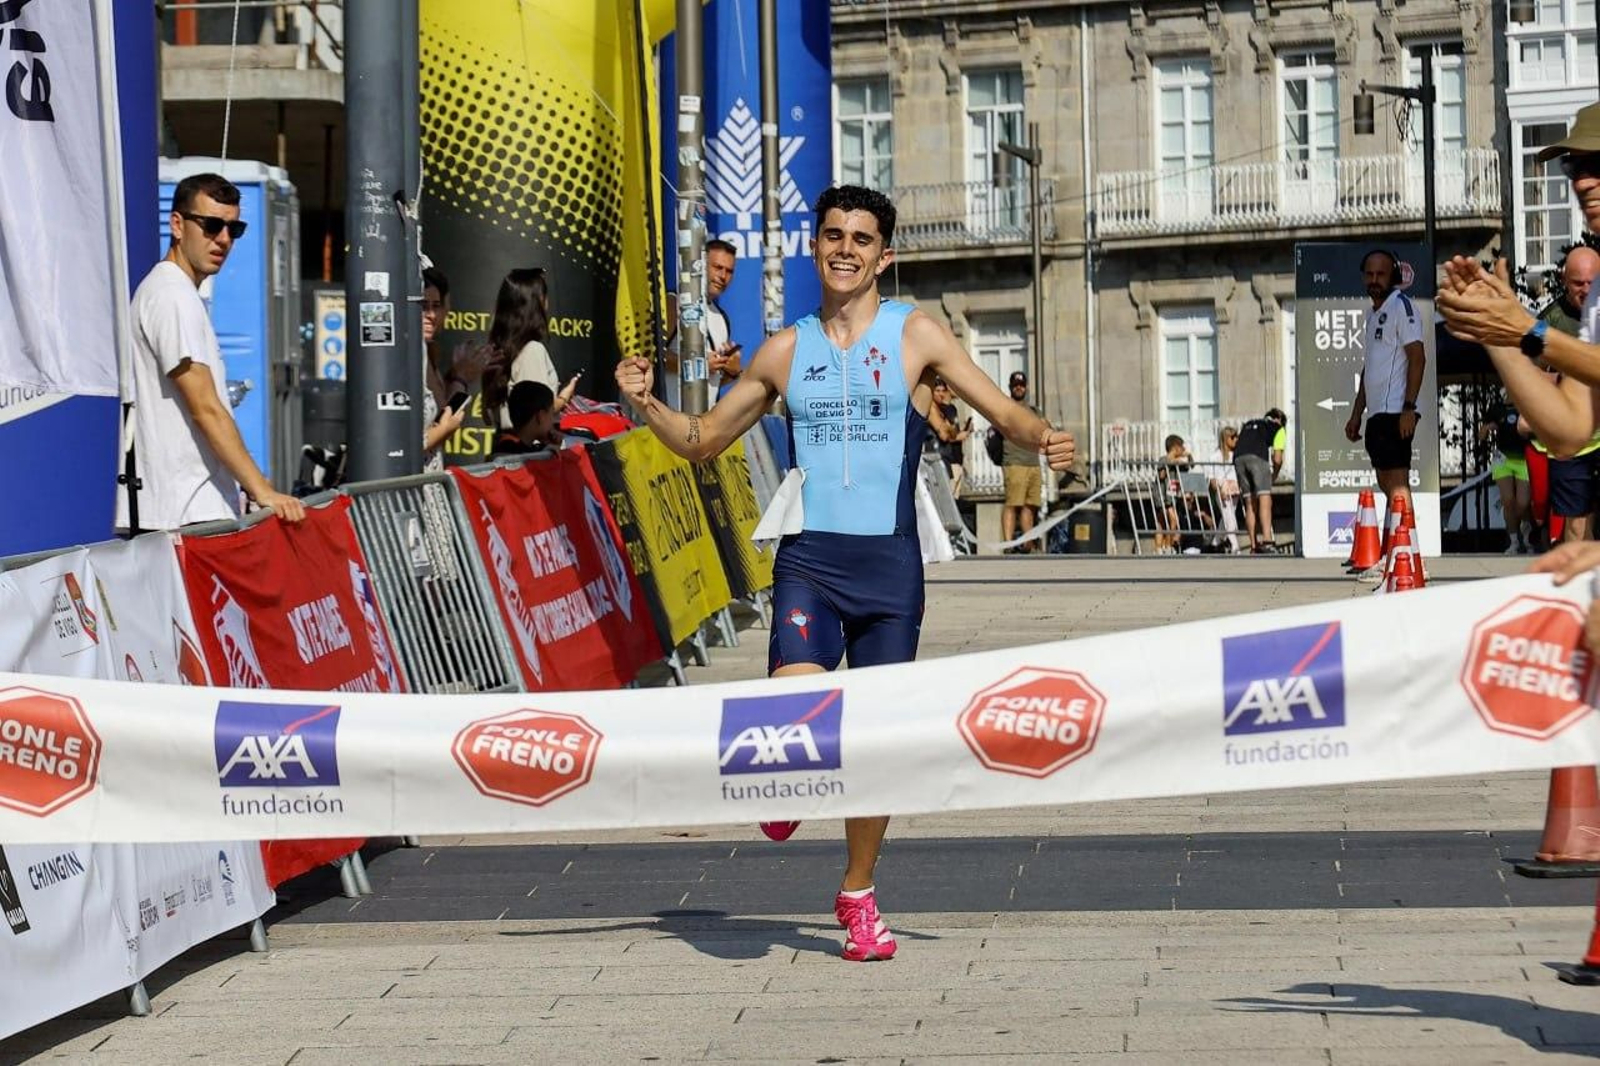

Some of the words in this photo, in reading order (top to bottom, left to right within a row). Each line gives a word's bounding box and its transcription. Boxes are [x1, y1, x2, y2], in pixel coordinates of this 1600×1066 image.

[444, 311, 491, 331] RIST
[549, 317, 594, 337] ACK?
[1315, 309, 1366, 330] MET
[809, 400, 858, 409] CONCELLO
[829, 424, 866, 432] XUNTA
[986, 696, 1087, 720] PONLE
[1224, 675, 1327, 727] AXA
[0, 718, 82, 759] ONLE
[482, 725, 585, 750] PONLE
[976, 709, 1081, 745] FRENO
[219, 734, 318, 779] AXA
[472, 736, 575, 776] FRENO
[720, 722, 822, 767] AXA
[1224, 736, 1349, 766] fundación
[0, 742, 78, 780] RENO
[721, 777, 845, 801] fundación
[222, 793, 344, 816] fundación
[28, 851, 85, 890] CHANGAN
